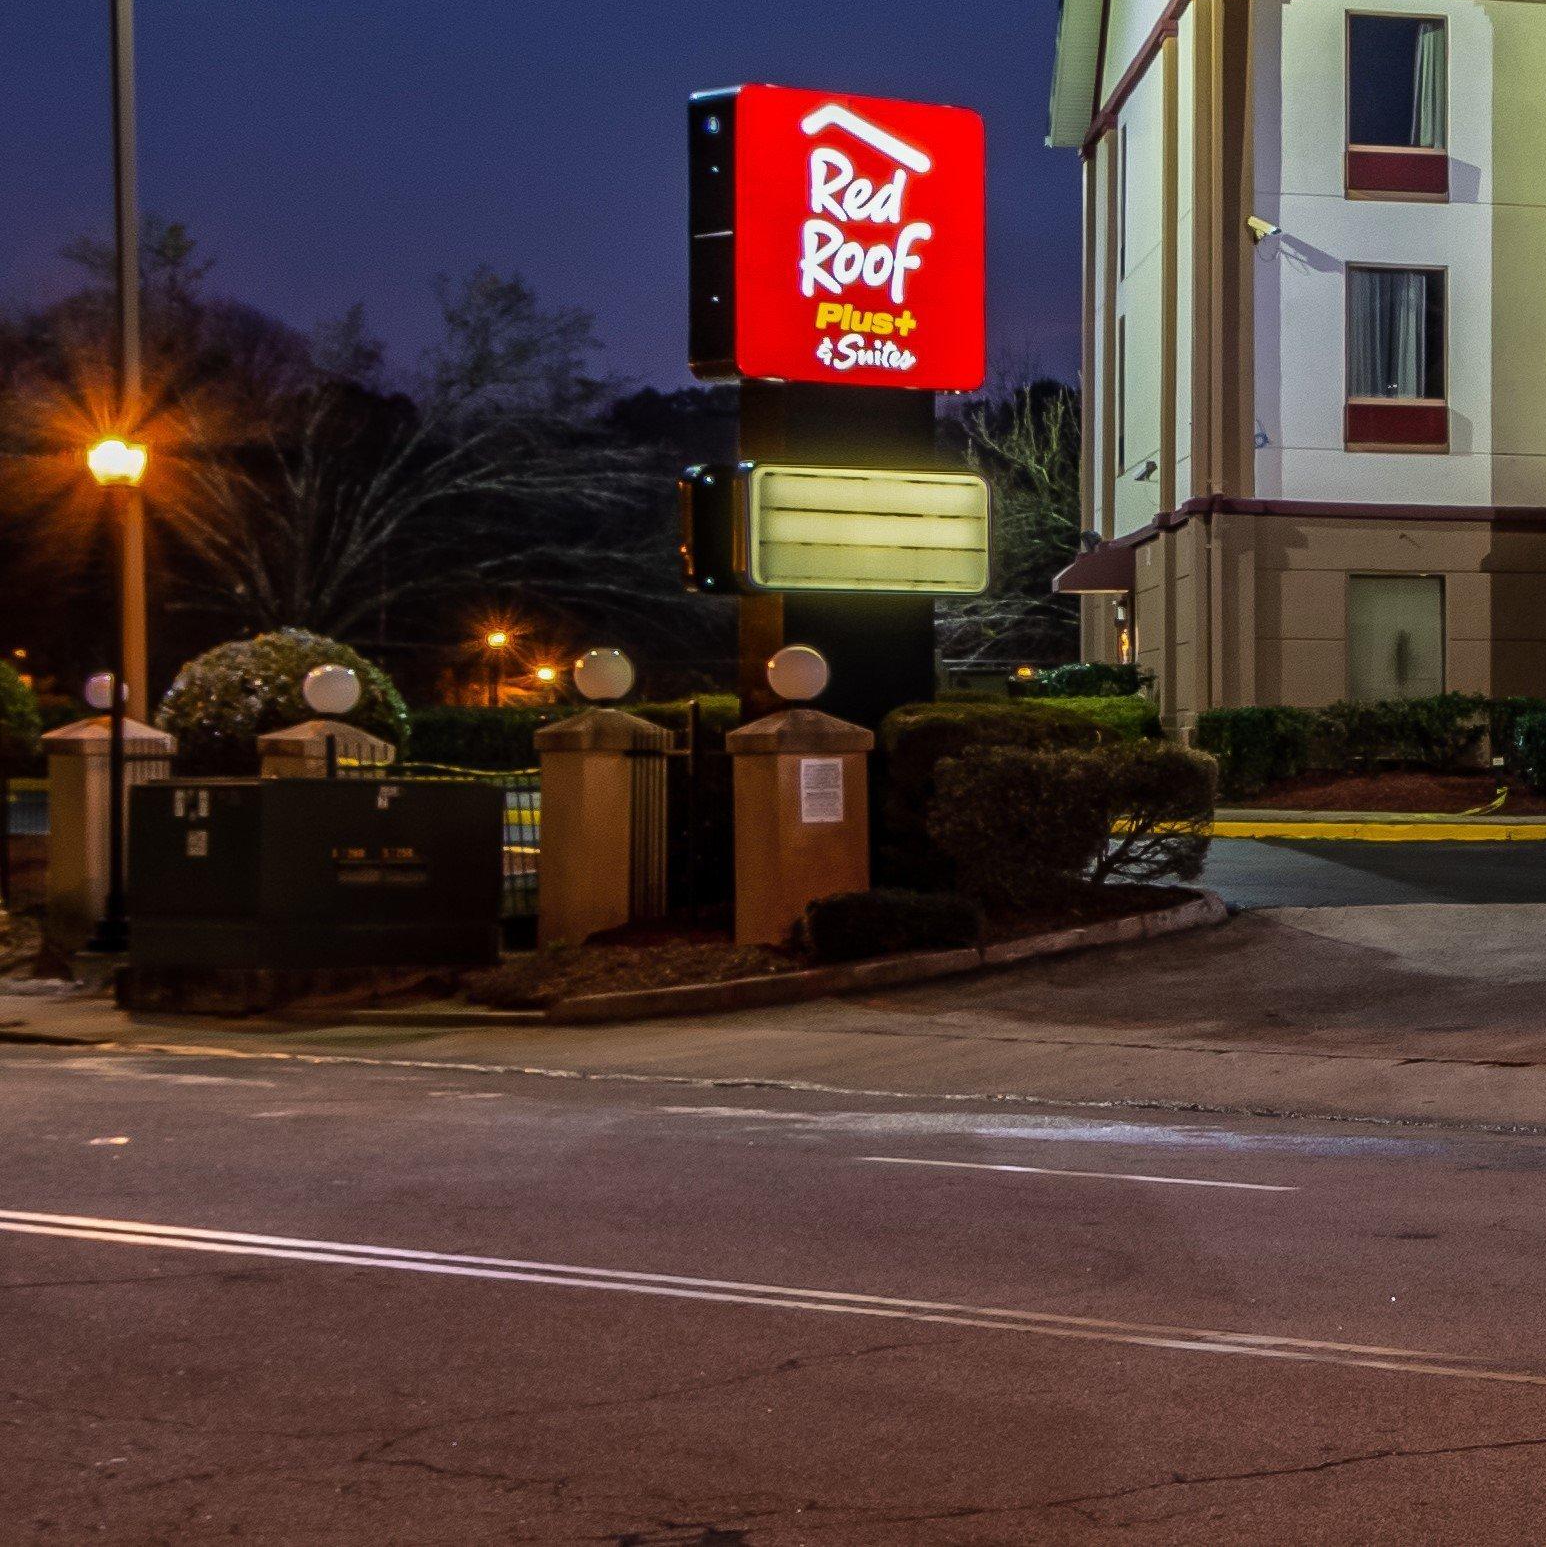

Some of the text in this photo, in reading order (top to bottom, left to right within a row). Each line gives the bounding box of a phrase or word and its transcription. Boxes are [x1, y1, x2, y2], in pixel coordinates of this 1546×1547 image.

[810, 147, 907, 223] Red
[800, 219, 932, 304] Roof
[815, 302, 917, 337] Plus+
[816, 333, 917, 370] & Suites
